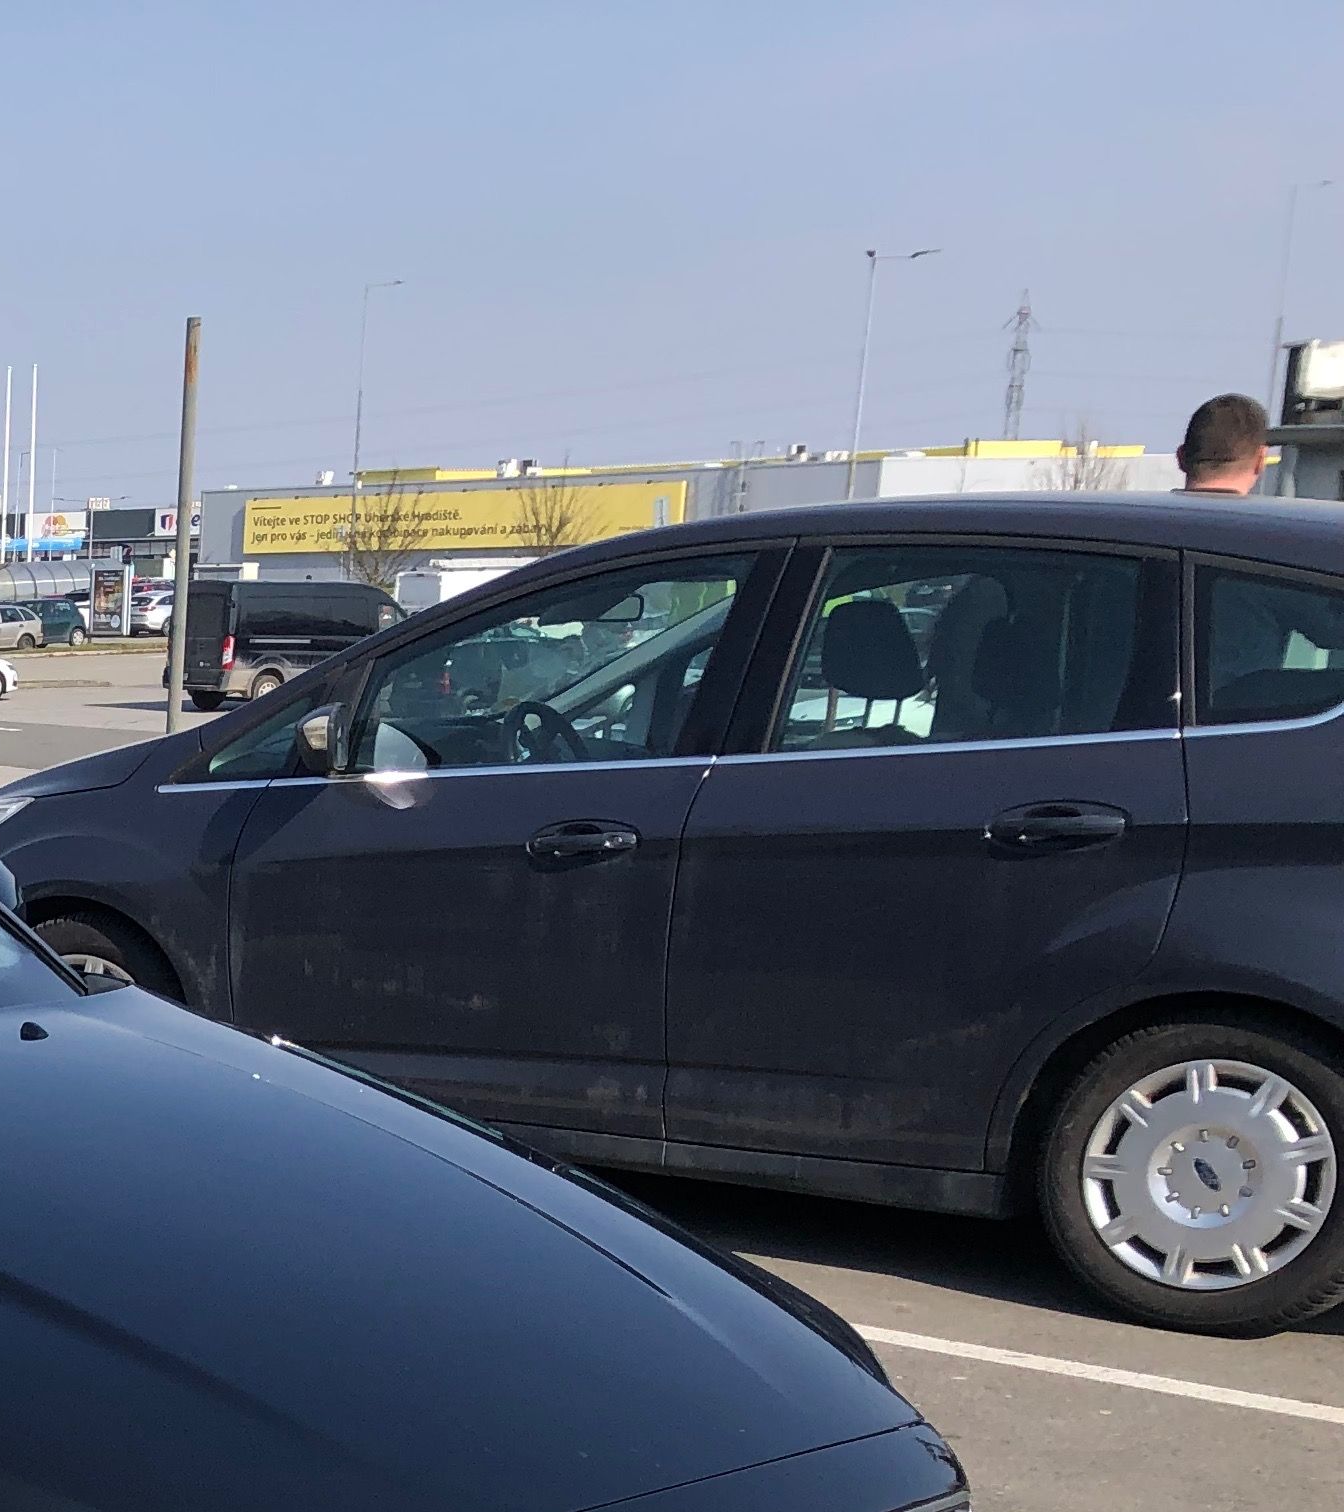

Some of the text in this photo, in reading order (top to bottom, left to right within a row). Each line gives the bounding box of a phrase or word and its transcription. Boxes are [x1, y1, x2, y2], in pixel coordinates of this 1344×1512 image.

[253, 515, 286, 529] Vítejte
[289, 517, 300, 525] ve
[303, 514, 330, 525] STOP
[251, 531, 268, 543] Jen
[271, 532, 287, 543] pro
[290, 529, 307, 540] vás
[500, 526, 507, 534] a
